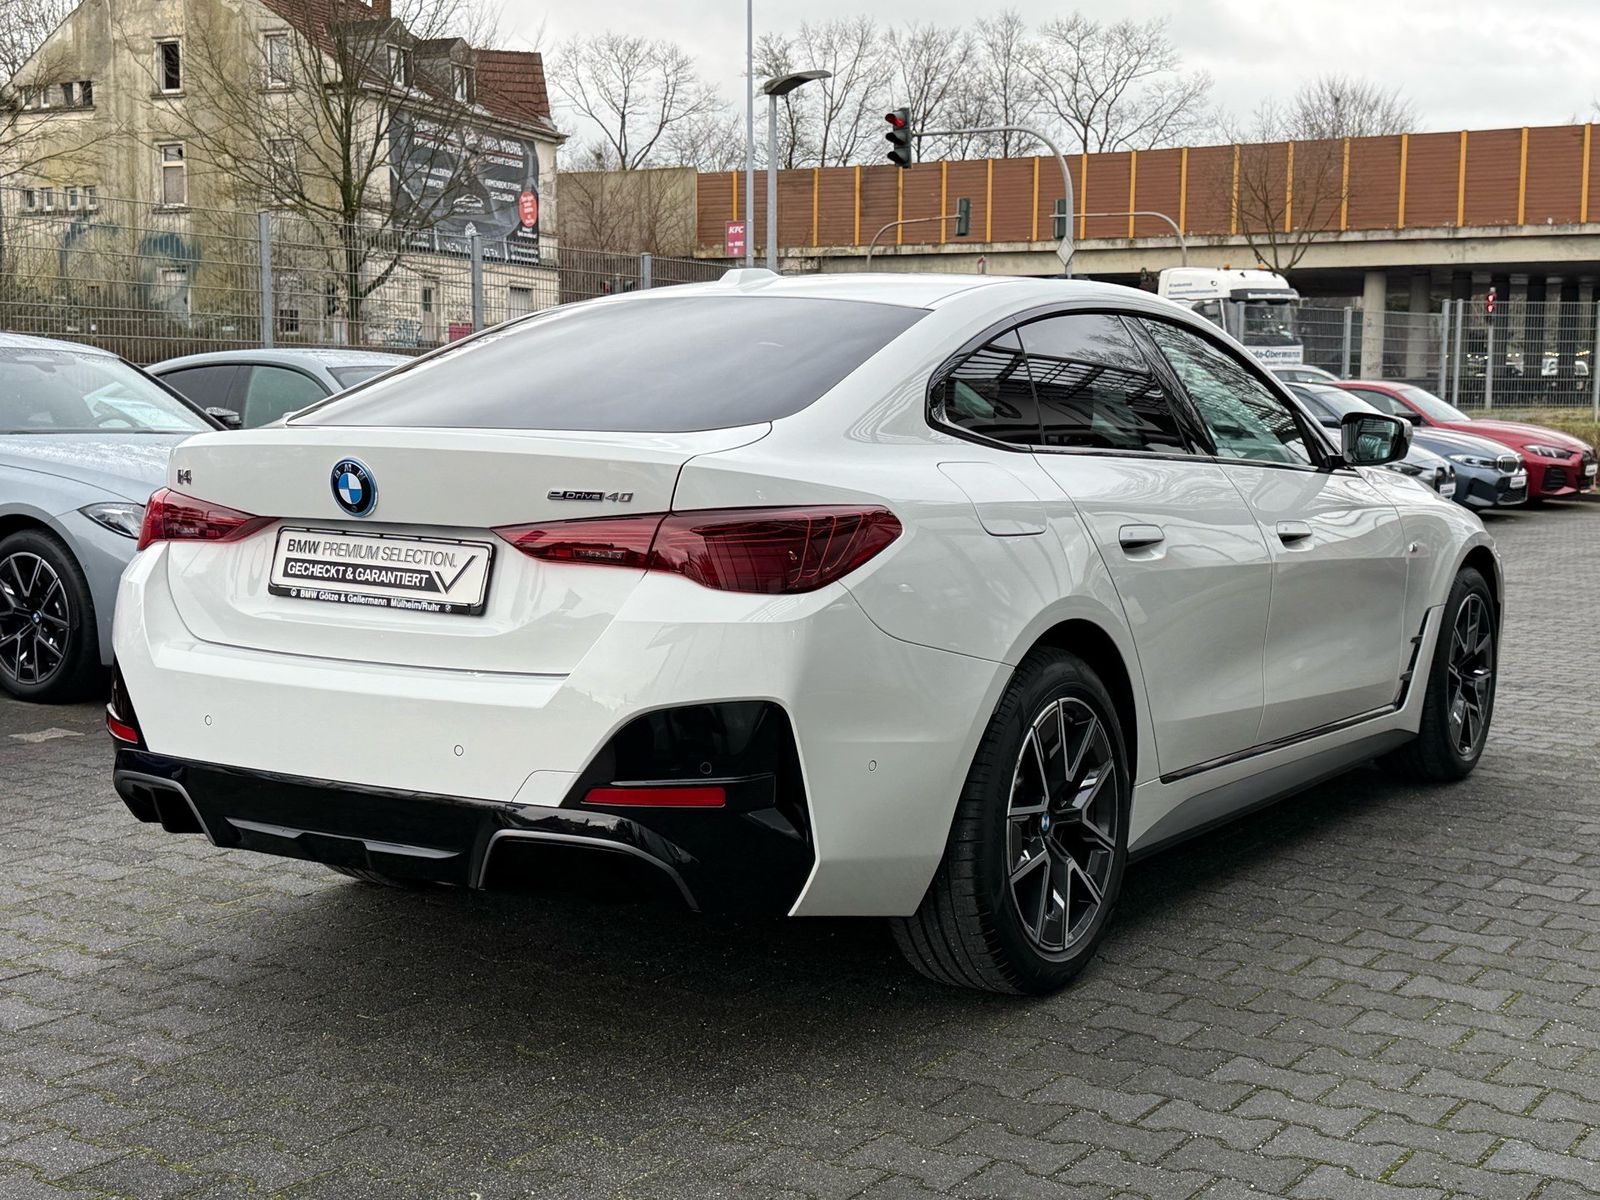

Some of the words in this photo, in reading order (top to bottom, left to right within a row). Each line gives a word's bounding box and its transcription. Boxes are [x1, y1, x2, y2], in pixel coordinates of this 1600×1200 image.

[728, 226, 744, 234] KFC
[334, 463, 366, 480] BMW
[287, 538, 320, 553] BMW
[322, 541, 380, 561] PREMIUM
[287, 561, 345, 580] GECHECKT
[345, 568, 354, 580] &
[355, 568, 429, 587] GARANTIERT
[300, 589, 317, 599] BMW
[319, 591, 339, 602] Götze
[340, 593, 346, 602] &
[347, 594, 387, 606] Gellermann
[390, 598, 440, 612] Mülheim/Ruhr
